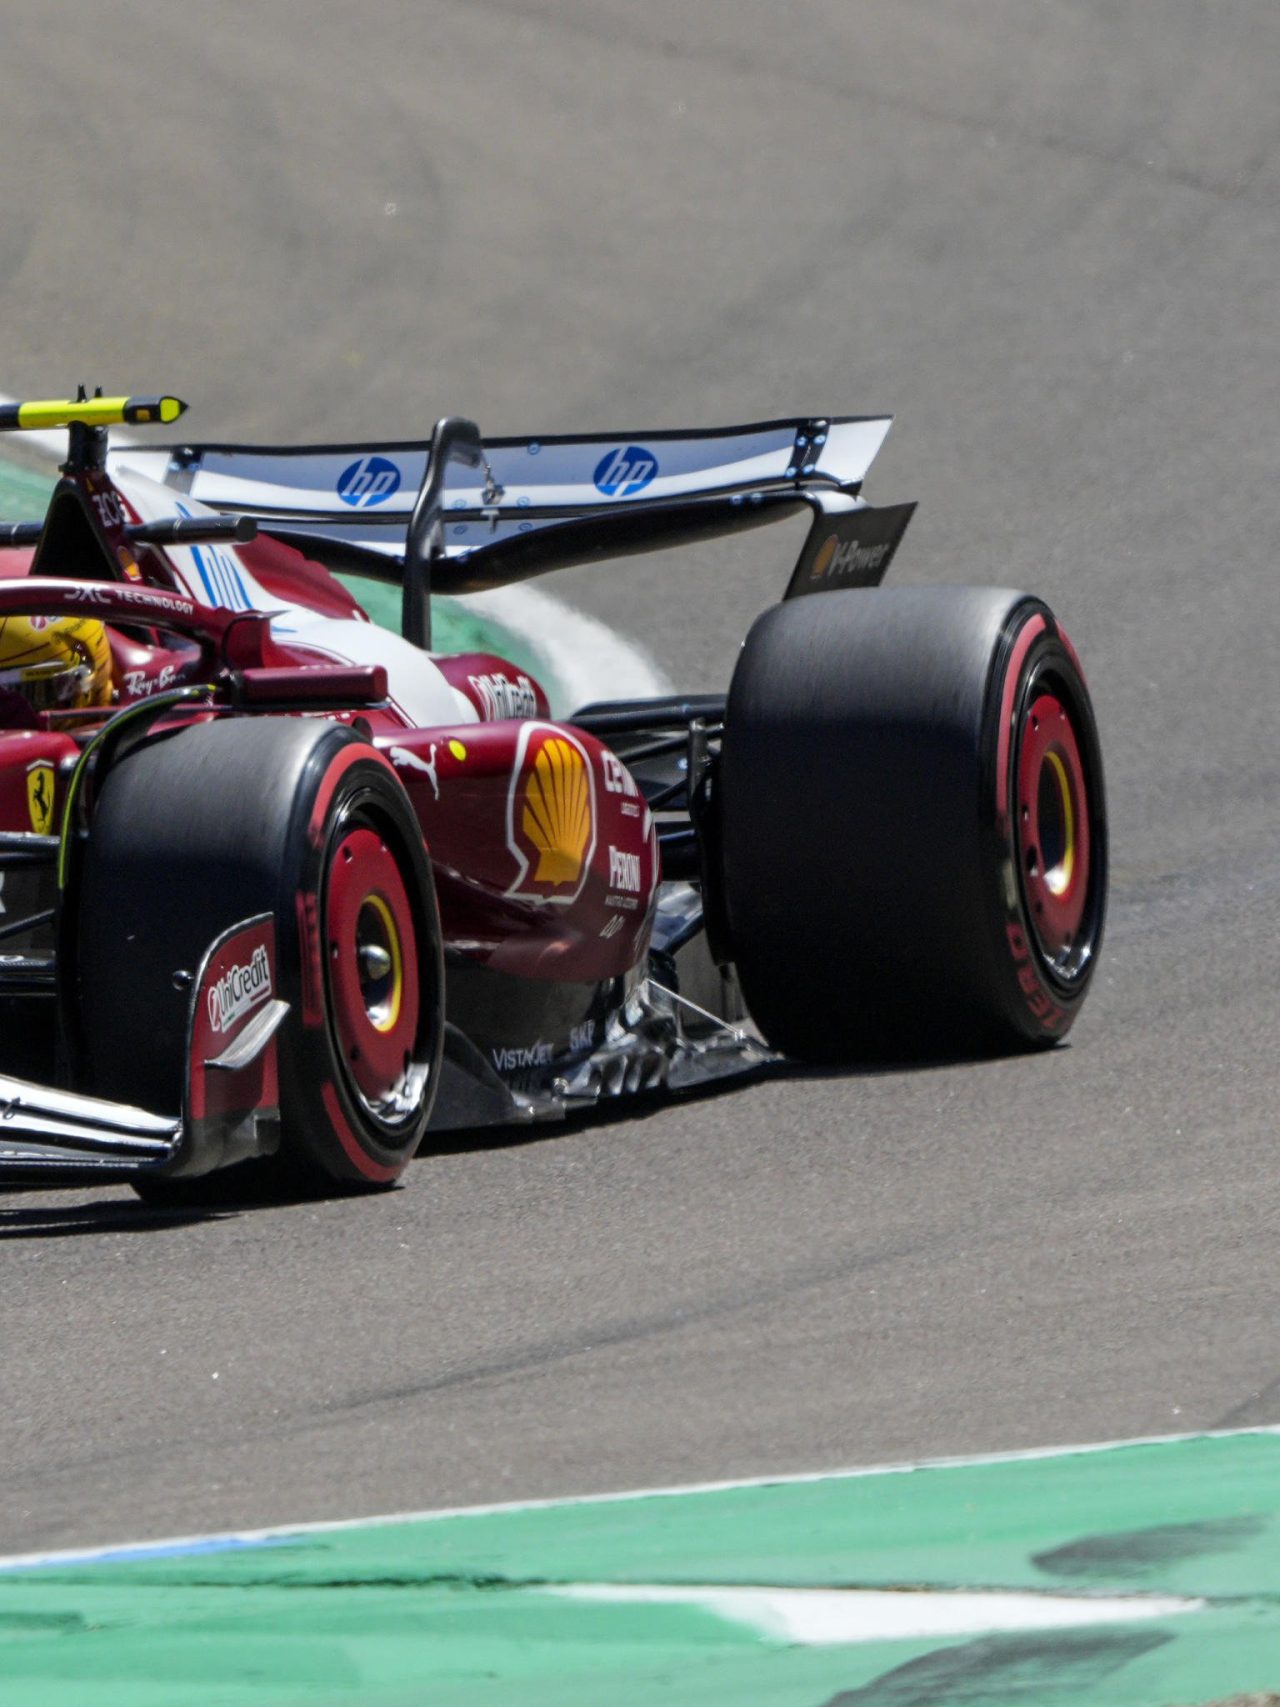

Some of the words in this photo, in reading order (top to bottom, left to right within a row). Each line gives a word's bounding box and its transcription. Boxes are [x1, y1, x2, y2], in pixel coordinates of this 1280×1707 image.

[337, 457, 400, 507] hp
[596, 446, 657, 496] hp
[116, 590, 194, 615] TECHNOLOGY
[219, 949, 270, 1017] UniCredit
